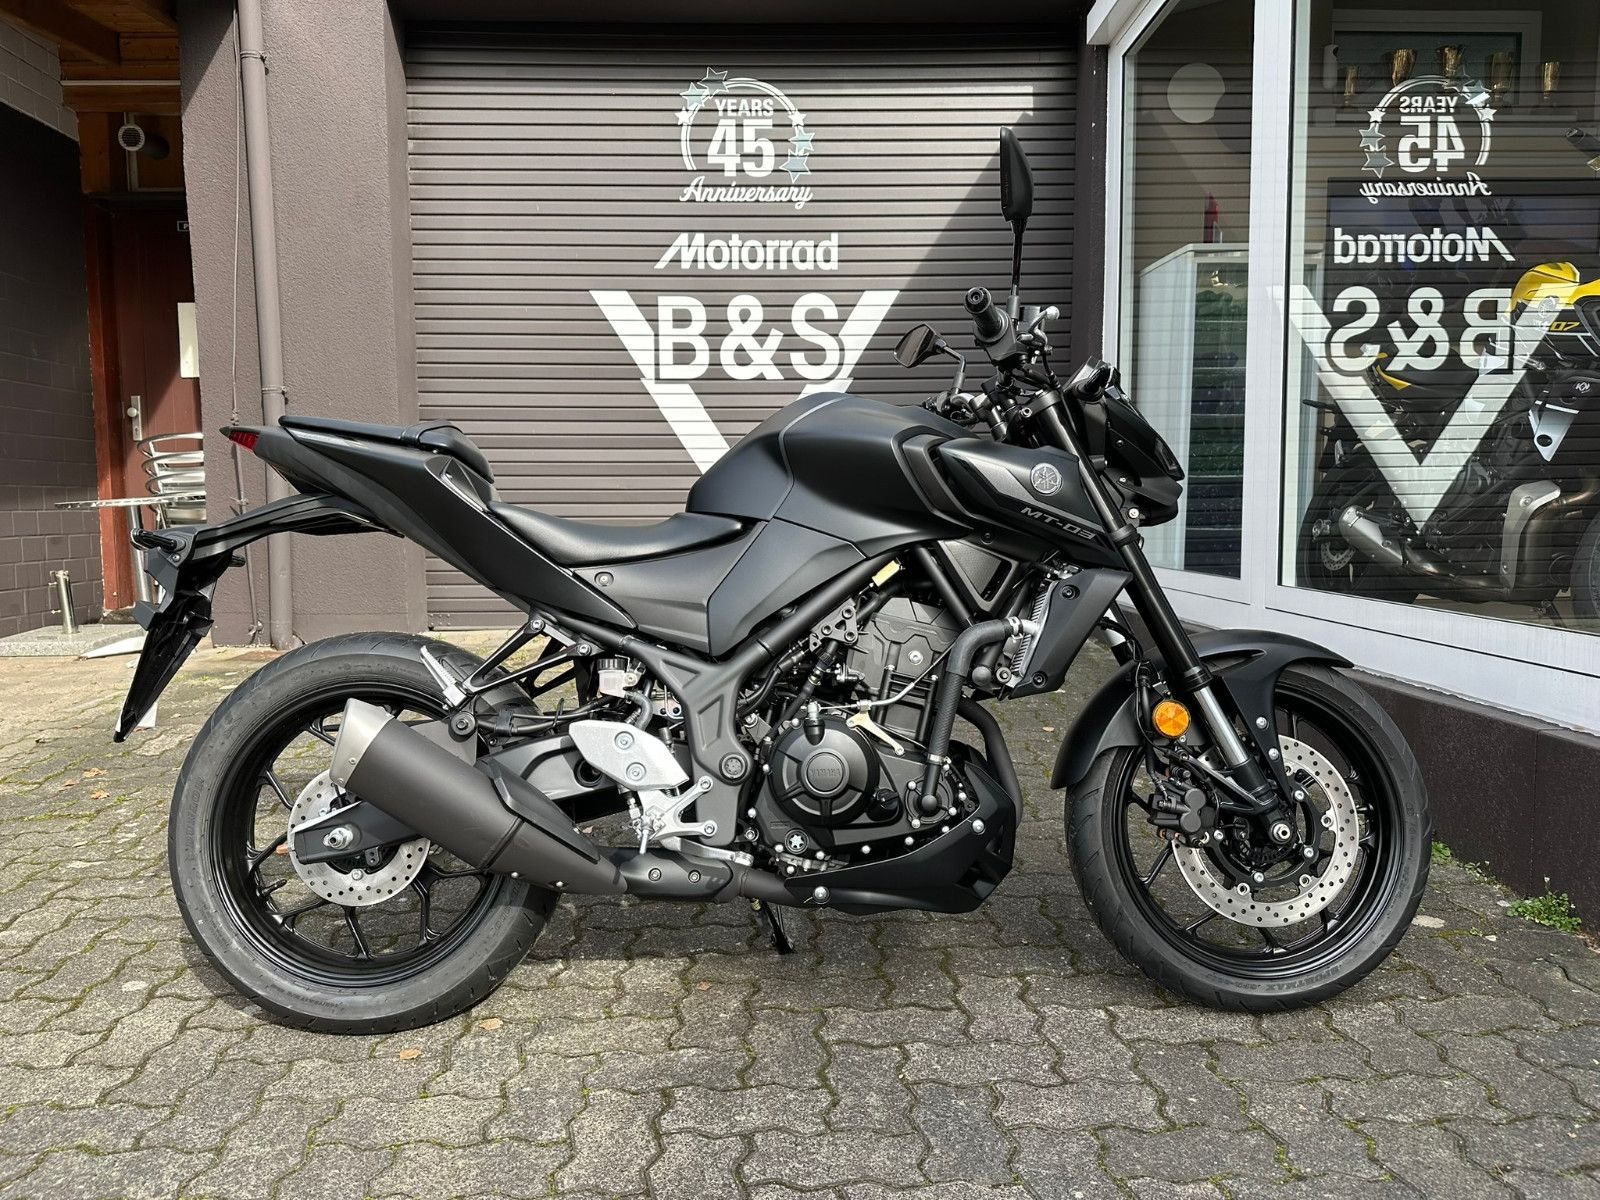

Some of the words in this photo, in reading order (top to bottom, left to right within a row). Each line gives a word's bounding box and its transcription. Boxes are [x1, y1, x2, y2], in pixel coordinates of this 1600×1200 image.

[715, 99, 774, 117] YEARS
[707, 119, 775, 177] 45
[679, 176, 814, 210] Anniversary
[654, 233, 839, 270] Motorrad
[657, 293, 840, 380] B&S
[1021, 507, 1096, 540] MT-03
